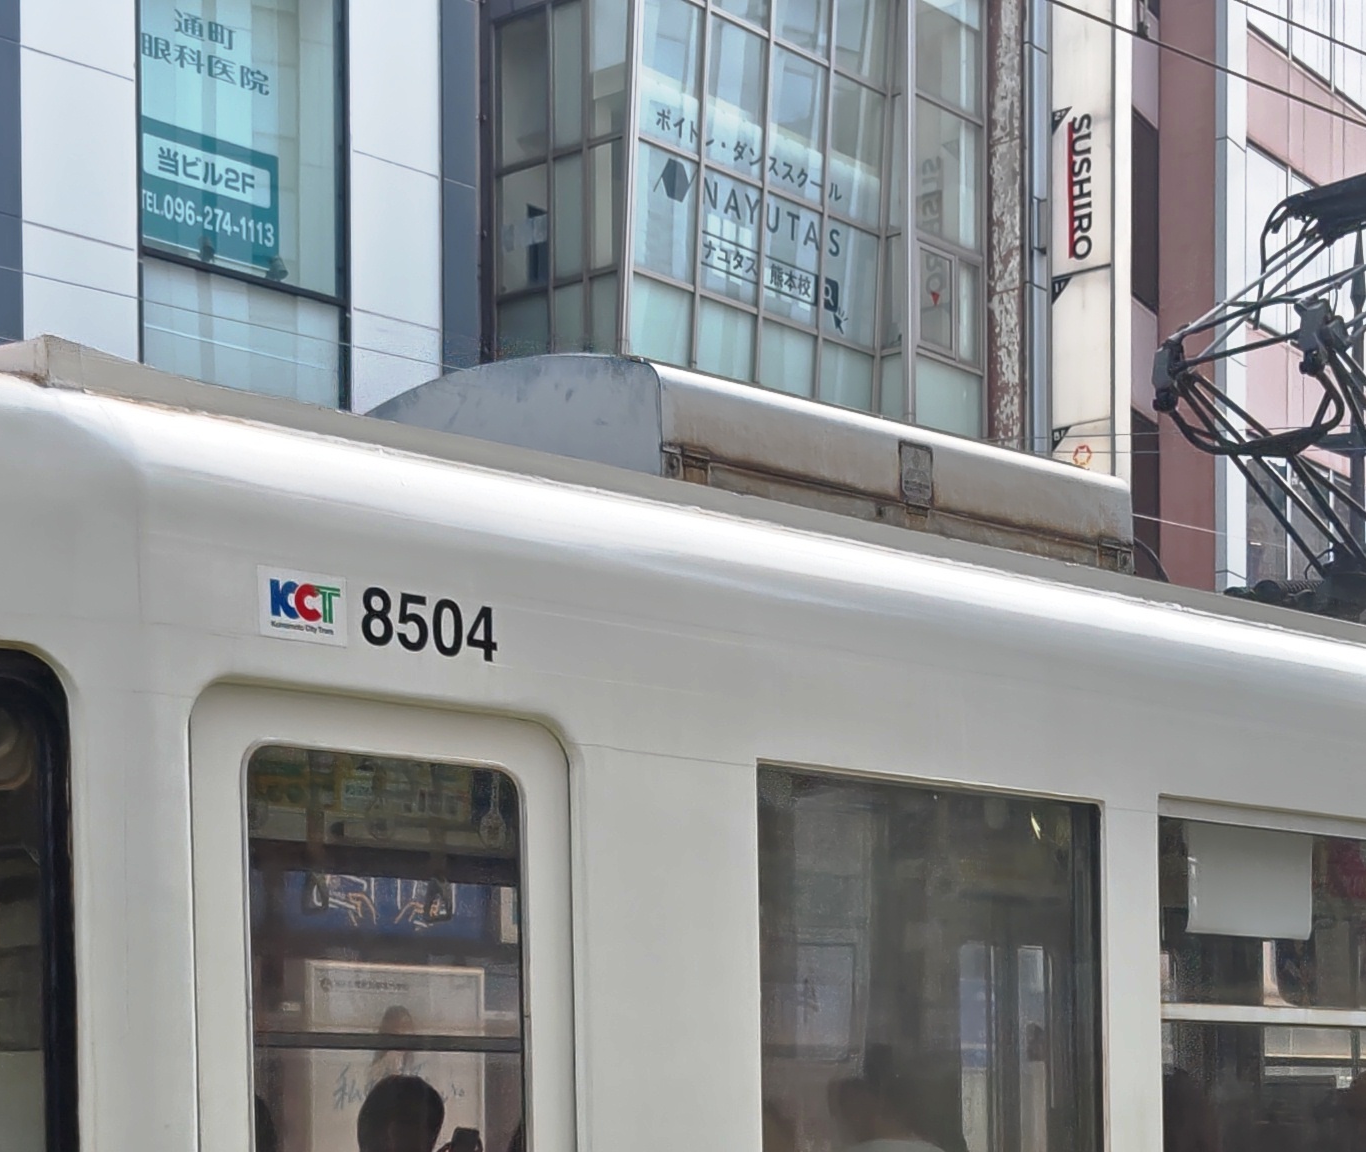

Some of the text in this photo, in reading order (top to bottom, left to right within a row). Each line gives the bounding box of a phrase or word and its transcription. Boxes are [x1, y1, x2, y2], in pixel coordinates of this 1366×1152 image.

[174, 8, 236, 50] 通町
[141, 32, 270, 96] 眼科医院
[158, 146, 255, 194] 当ビル2F
[1073, 113, 1093, 261] SUSHIRO
[704, 177, 841, 257] NAYUTAS
[703, 240, 812, 298] ナユタス 熊本校
[269, 578, 341, 624] KCT
[361, 587, 498, 662] 8504
